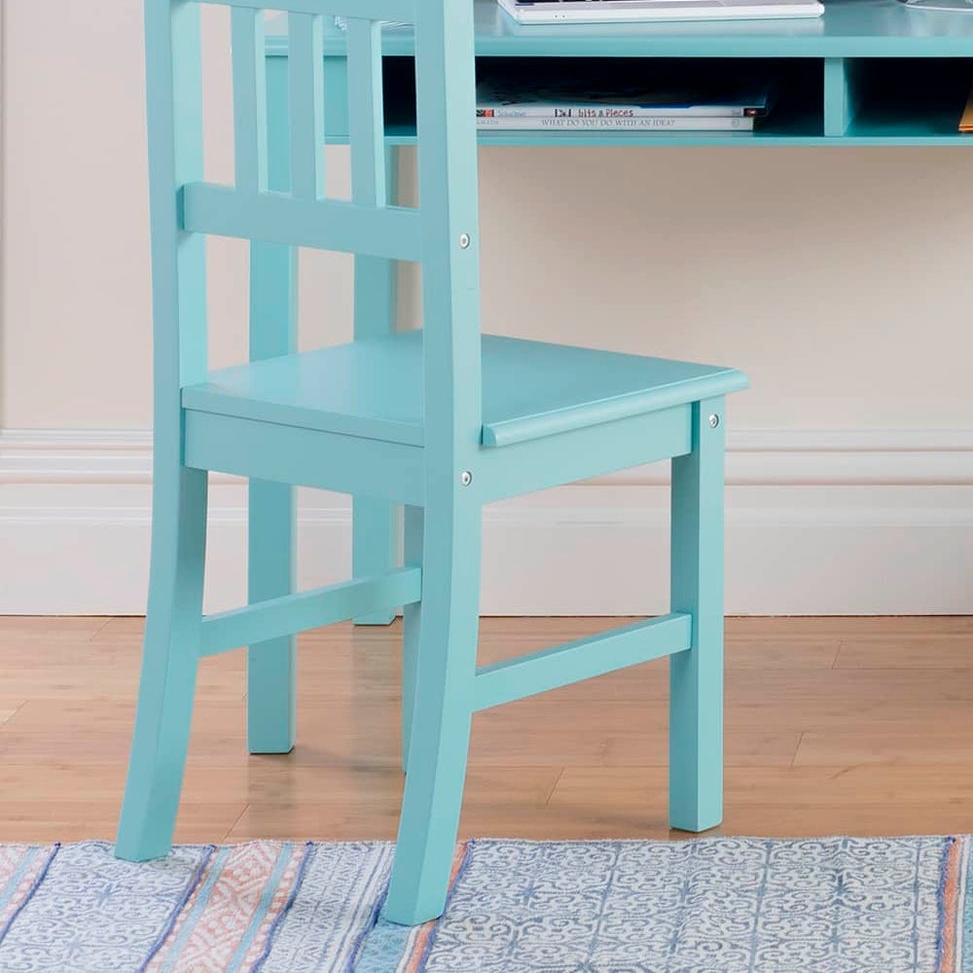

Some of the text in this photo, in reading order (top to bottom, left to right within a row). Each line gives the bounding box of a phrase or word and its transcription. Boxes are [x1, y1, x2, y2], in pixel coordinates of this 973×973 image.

[578, 109, 597, 118] bits
[605, 109, 634, 118] Pieces
[542, 119, 676, 127] WHAT DO YOU DO WITH AN IDEA?
